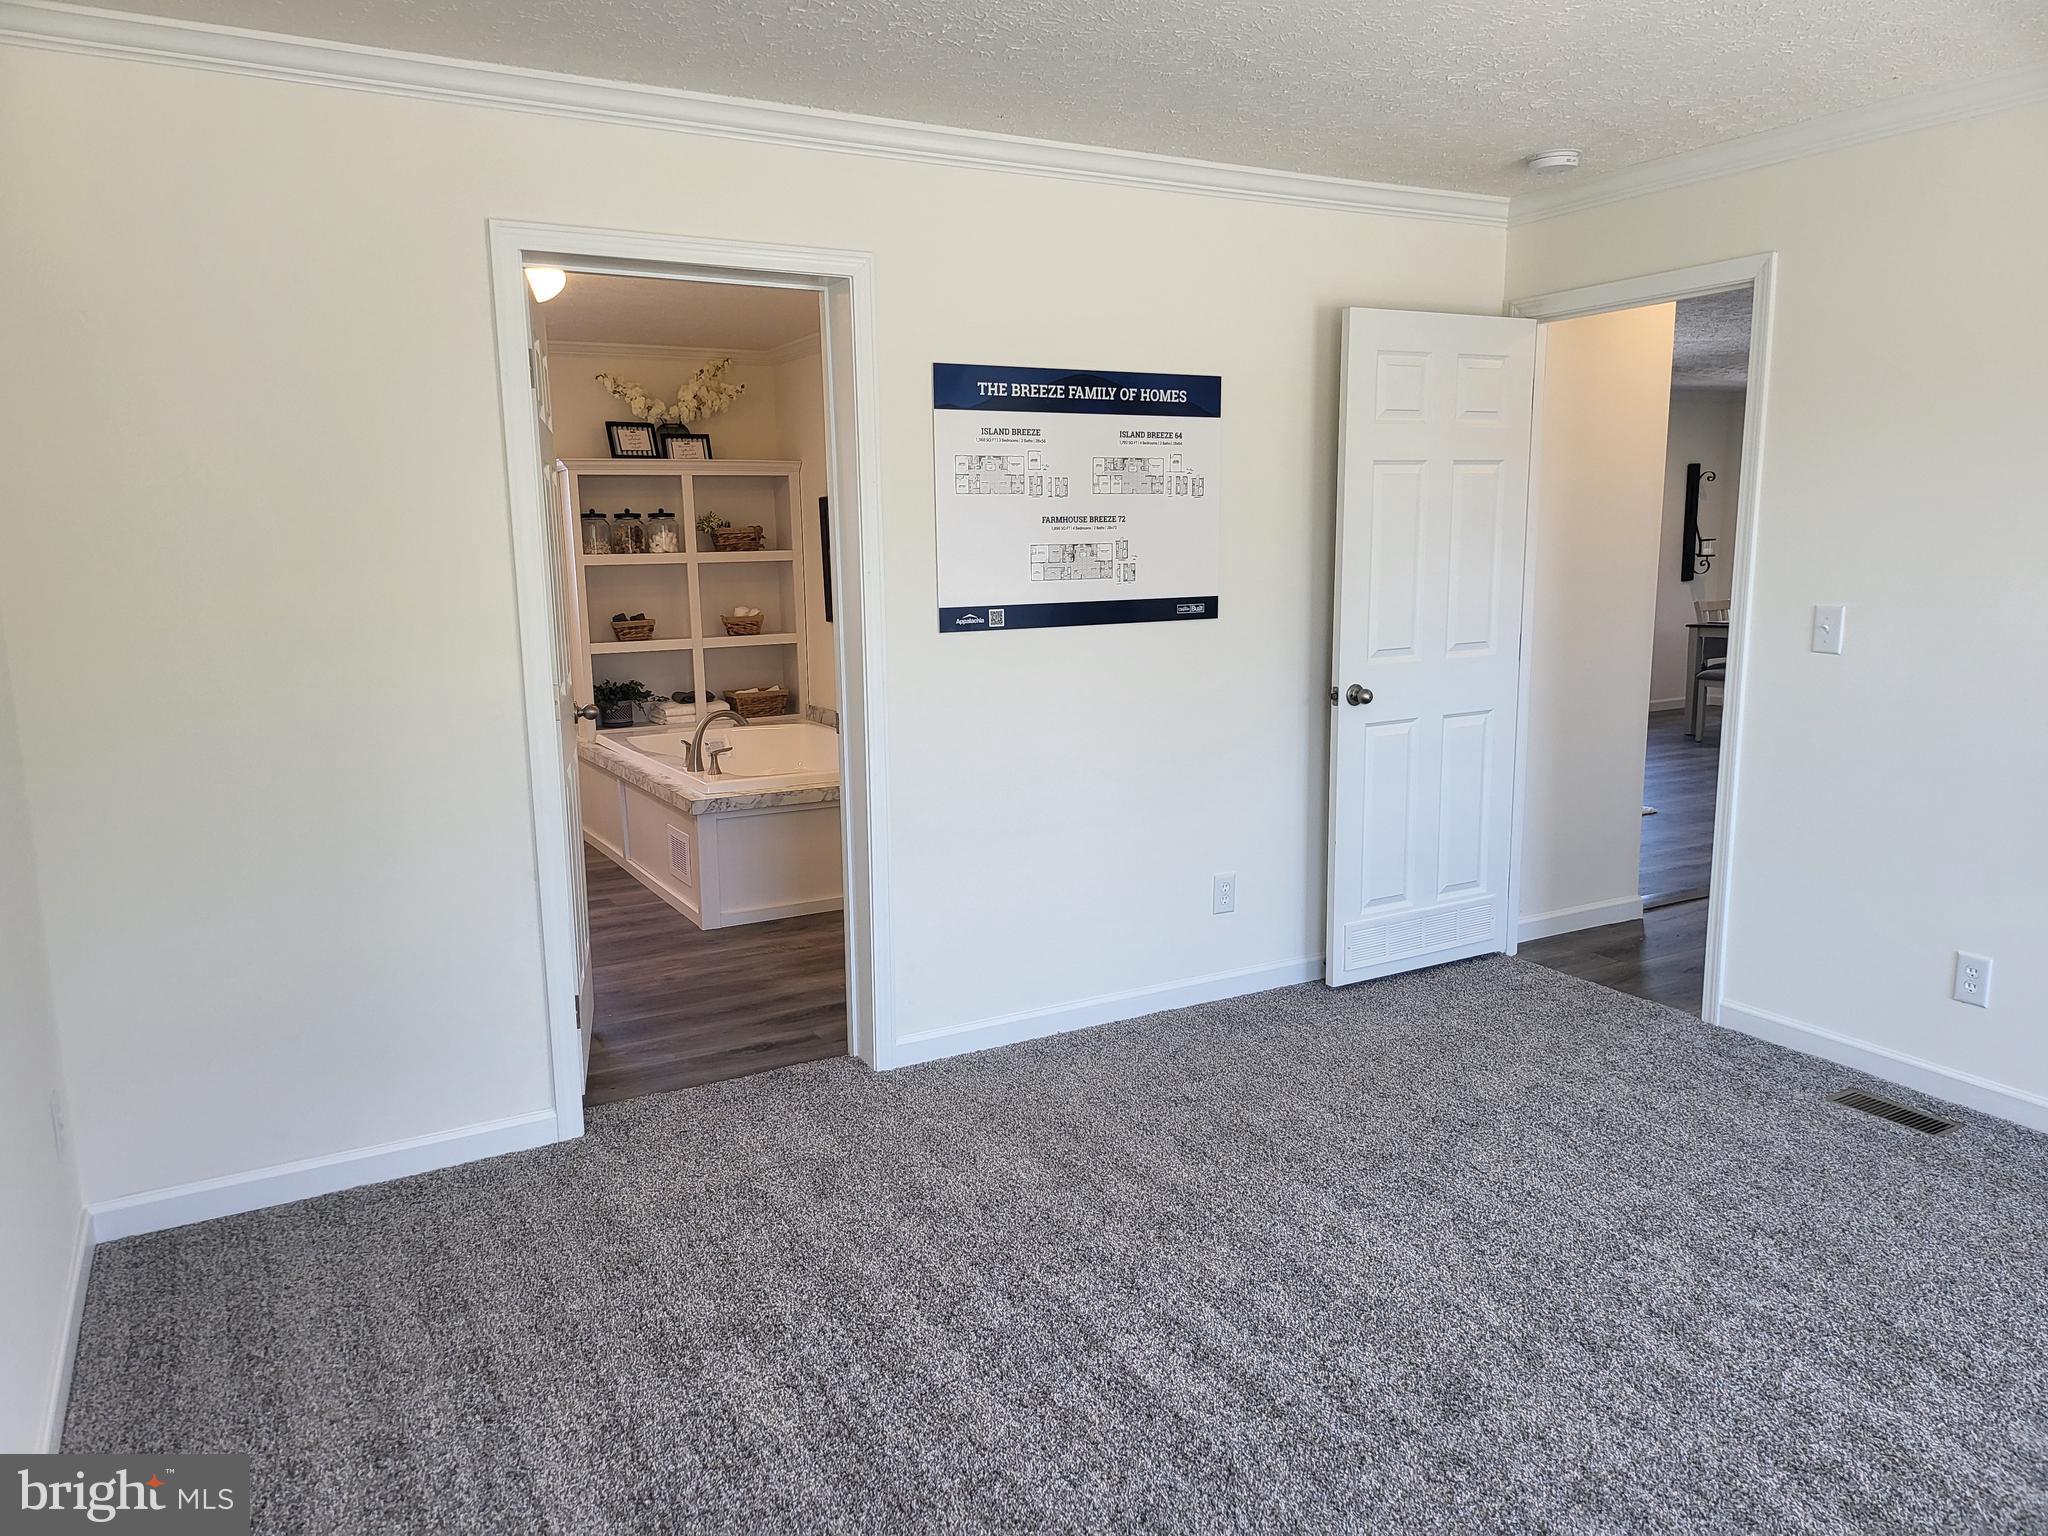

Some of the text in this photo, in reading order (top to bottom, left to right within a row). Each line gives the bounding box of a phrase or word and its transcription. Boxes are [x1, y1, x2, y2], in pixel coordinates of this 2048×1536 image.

[977, 381, 1187, 403] THE BREEZE FAMILY OF HOMES
[981, 427, 1041, 437] ISLAND BREEZE
[1119, 430, 1146, 439] ISLAND
[1147, 431, 1174, 439] BREEZE
[1041, 515, 1126, 524] FARMHOUSE BREEZE 72
